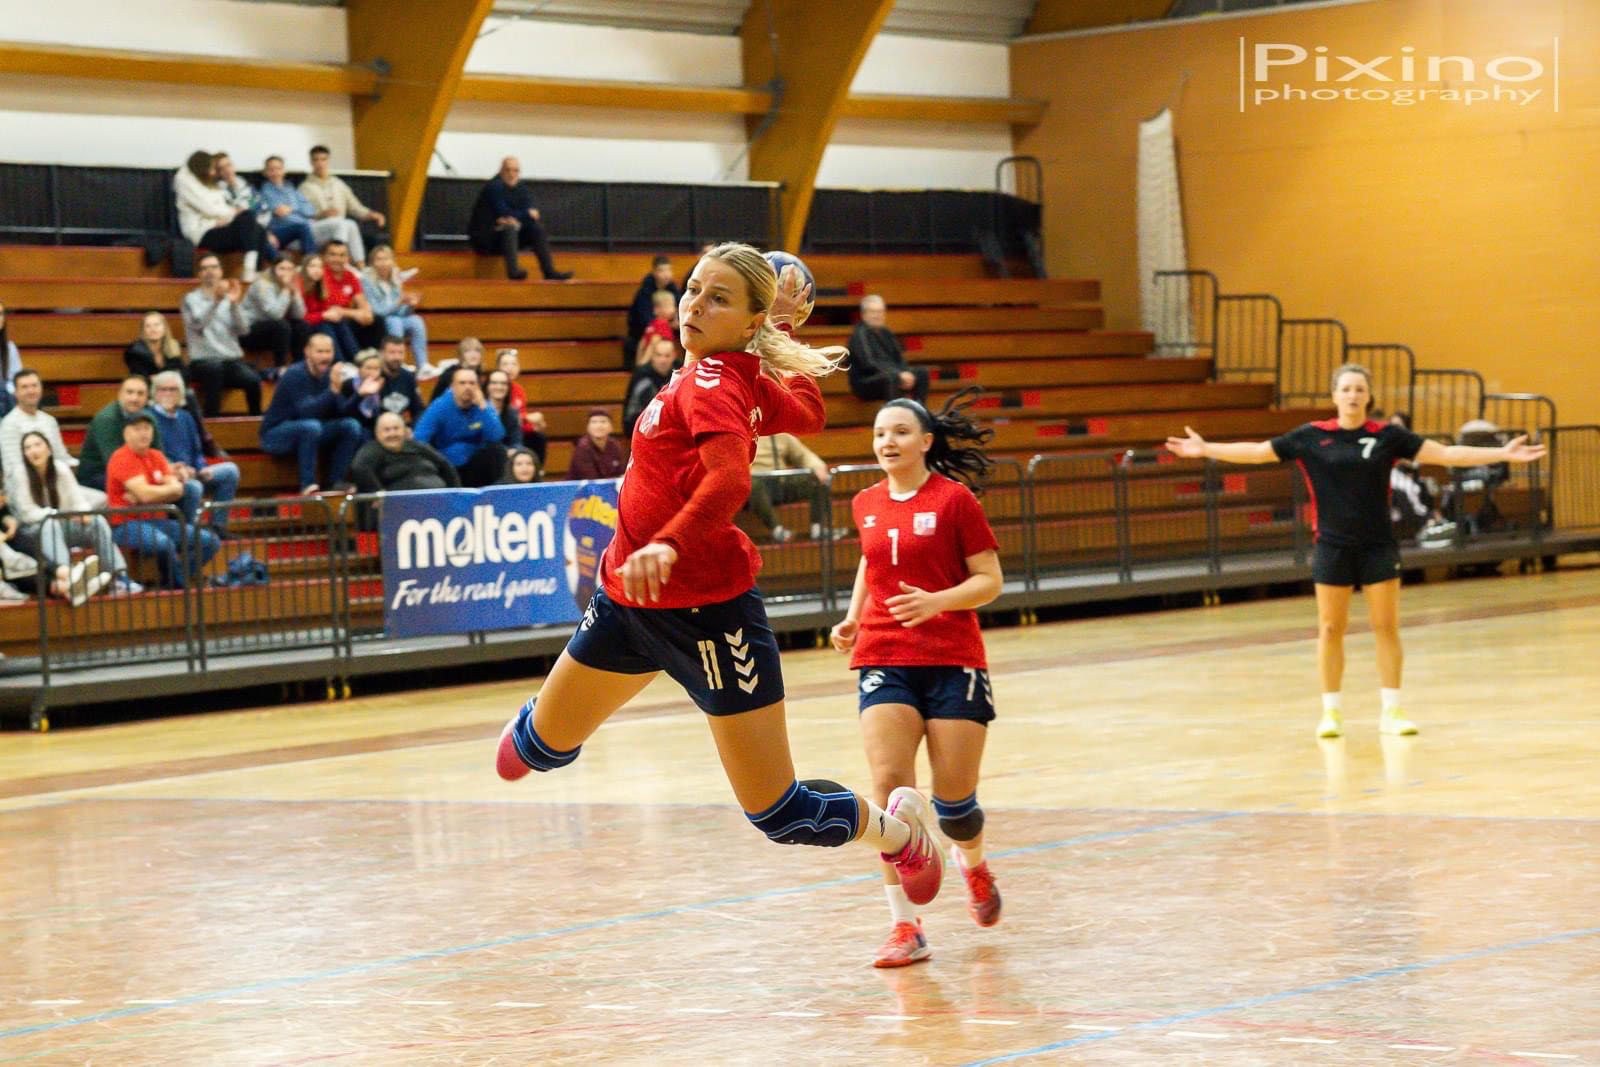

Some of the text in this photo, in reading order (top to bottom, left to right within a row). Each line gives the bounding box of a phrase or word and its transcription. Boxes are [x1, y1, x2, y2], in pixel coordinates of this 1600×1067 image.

[1357, 436, 1378, 460] 7
[397, 504, 556, 570] molten
[391, 571, 558, 610] For the real game
[697, 639, 724, 690] 11
